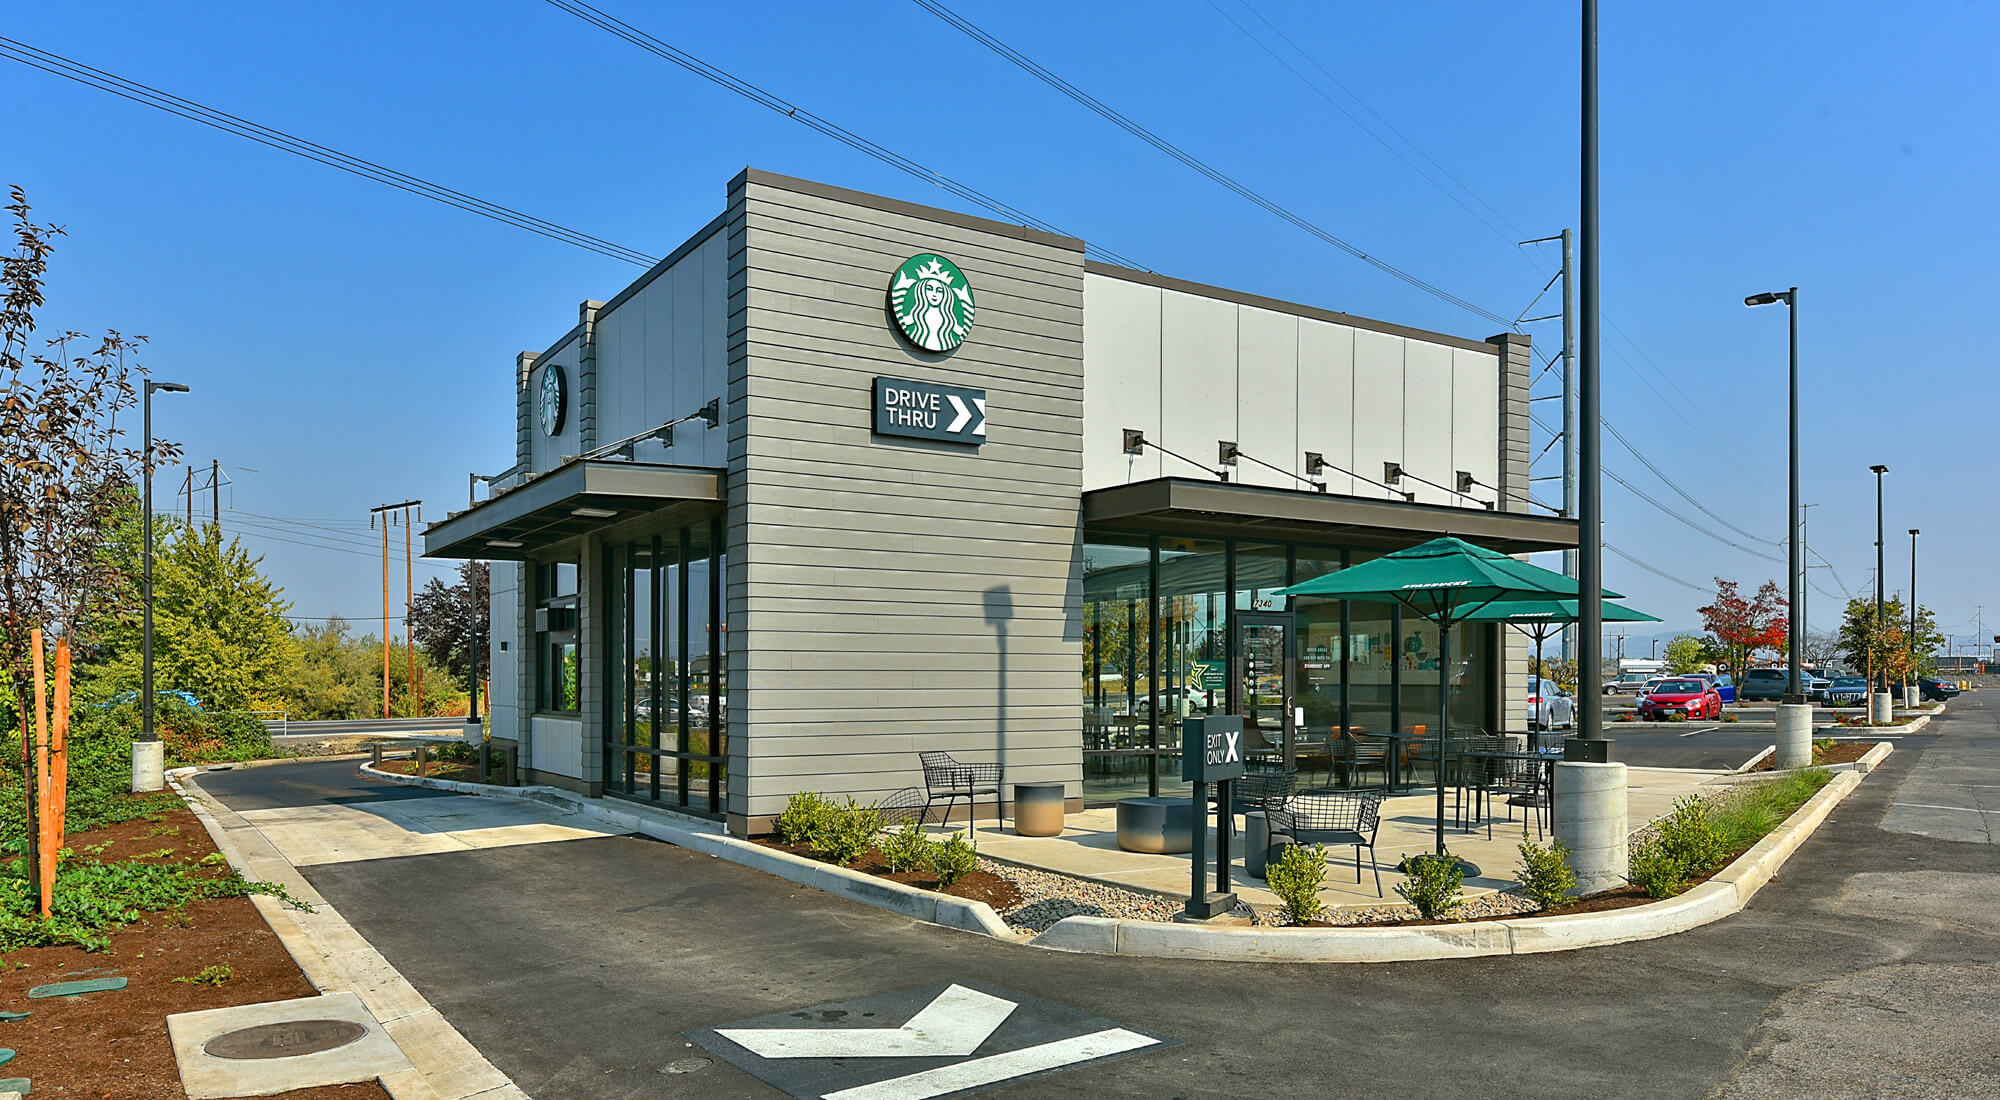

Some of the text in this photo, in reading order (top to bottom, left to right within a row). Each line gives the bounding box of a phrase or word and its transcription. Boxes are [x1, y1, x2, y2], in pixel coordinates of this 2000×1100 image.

[885, 388, 940, 411] DRIVE
[885, 407, 936, 429] THRU
[1253, 599, 1272, 609] 7340
[1207, 733, 1222, 749] EXIT
[1207, 749, 1225, 765] ONLY
